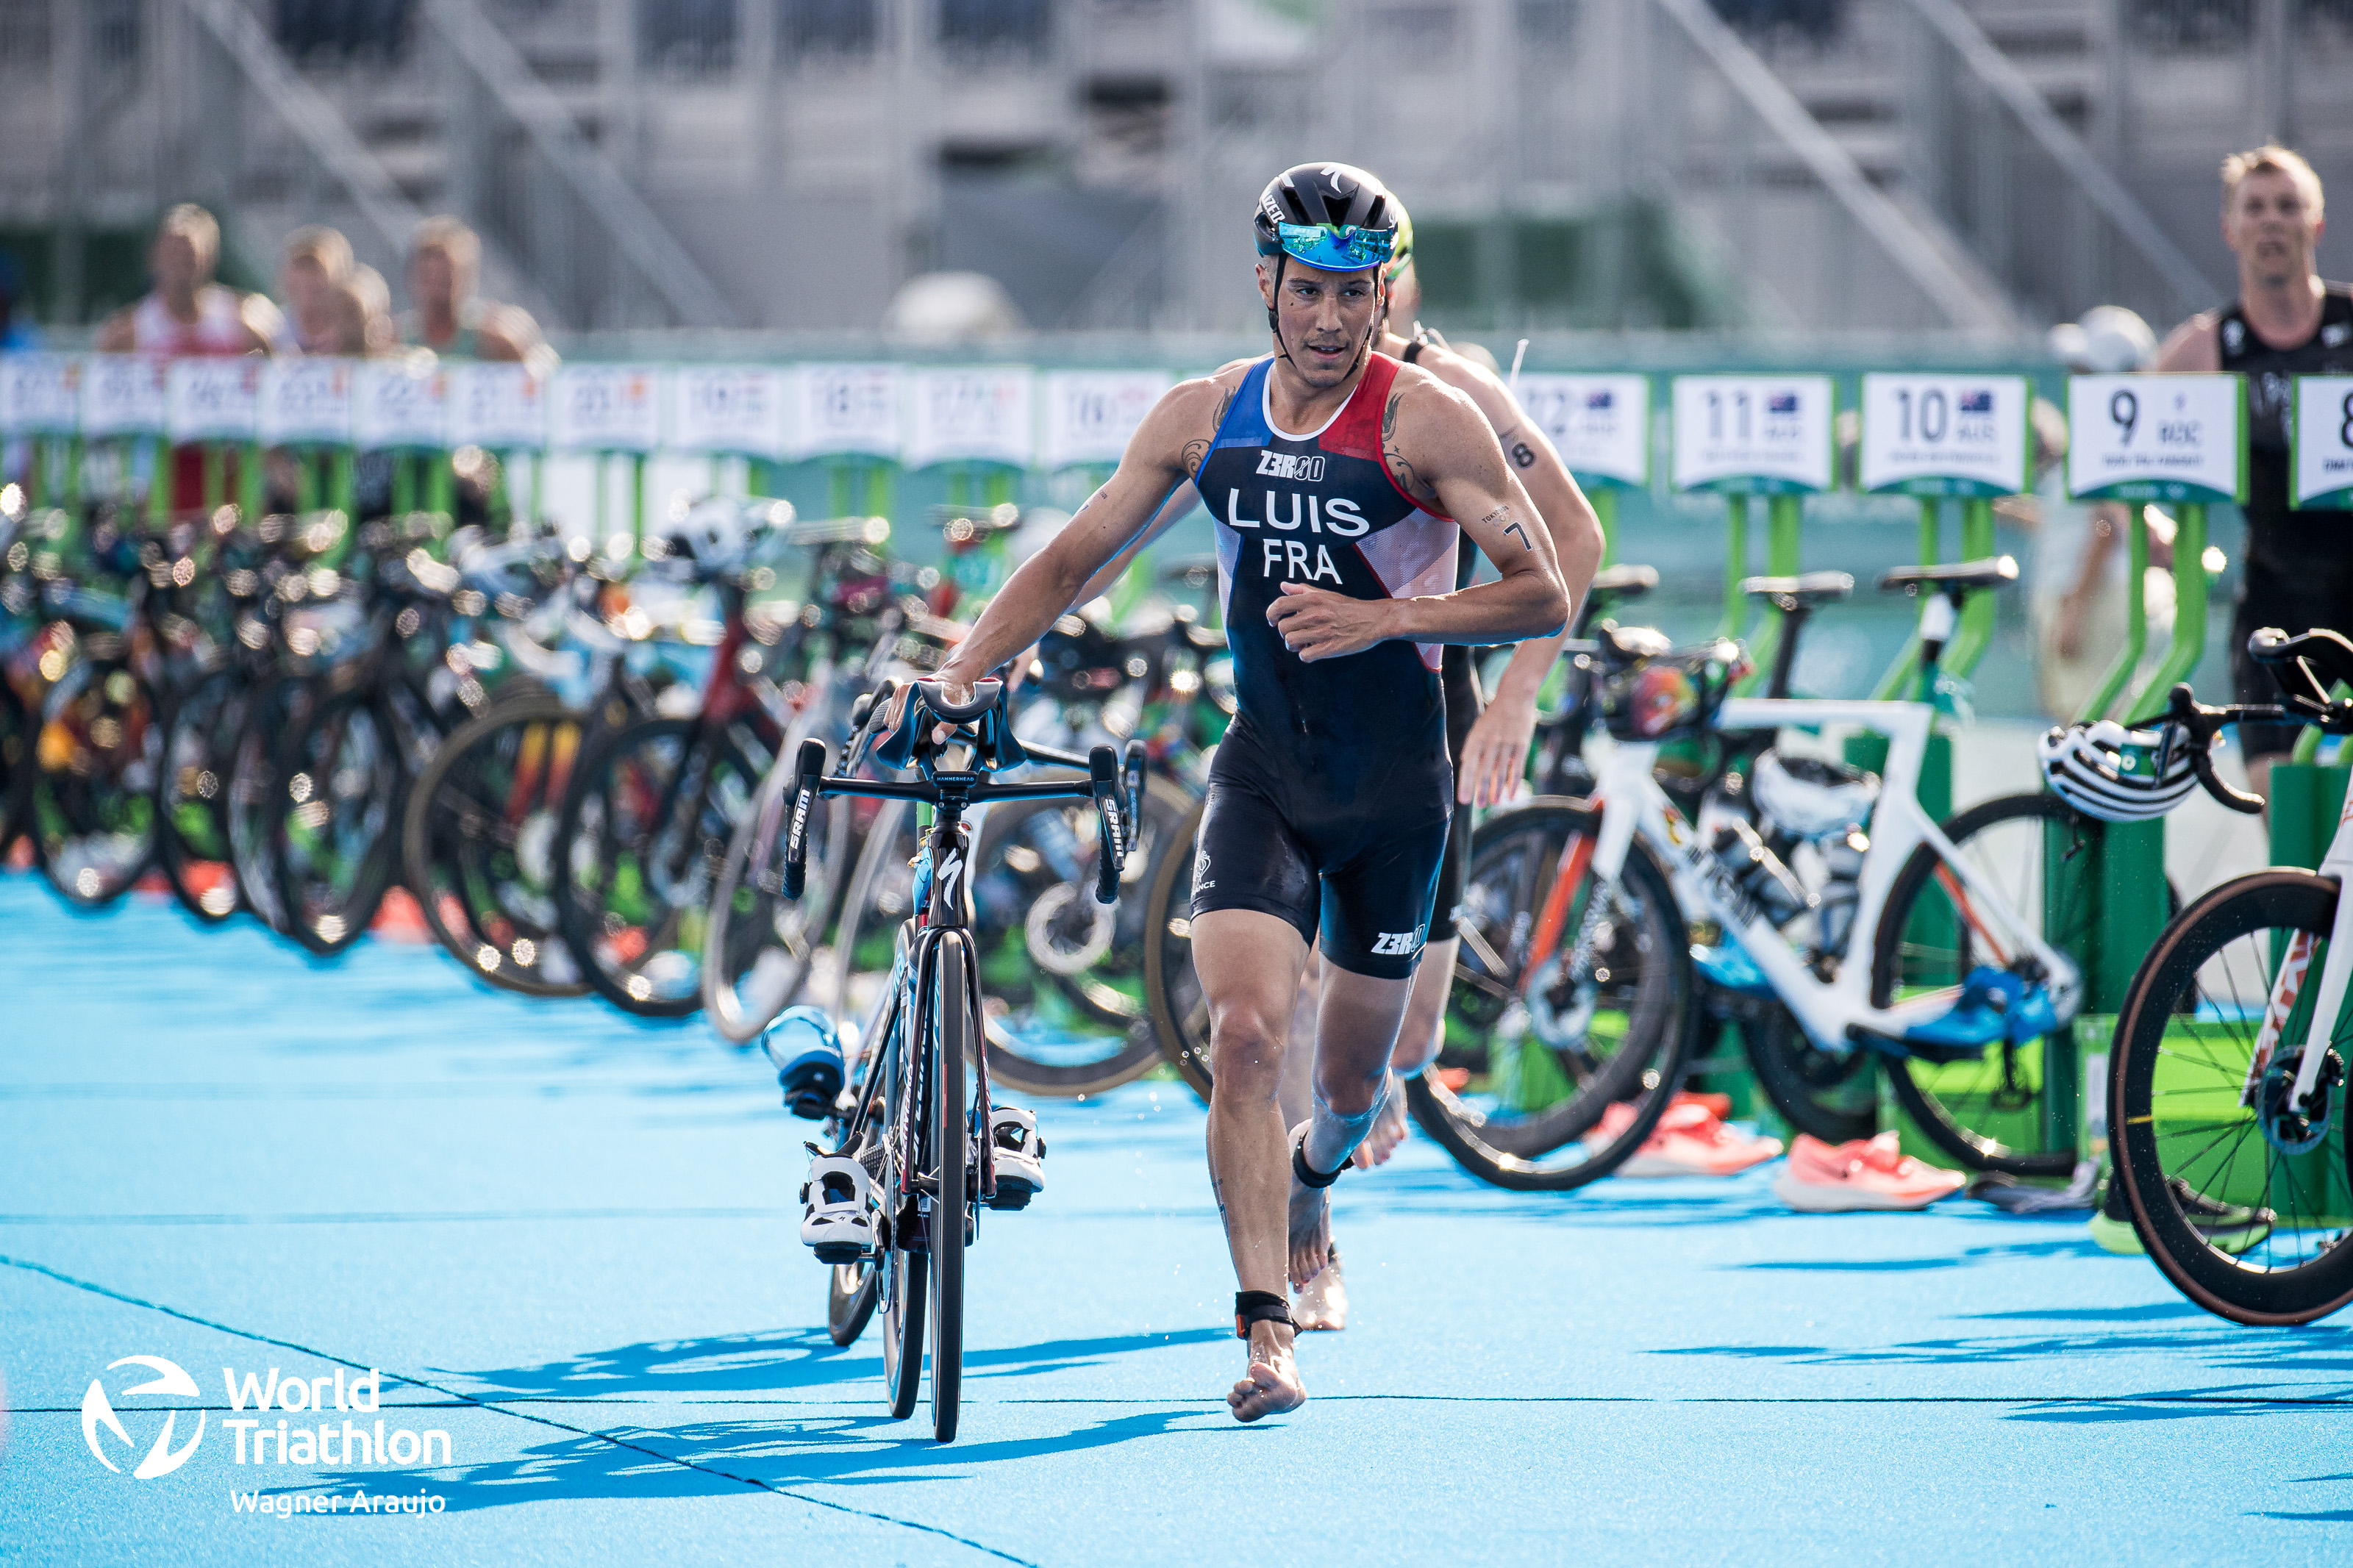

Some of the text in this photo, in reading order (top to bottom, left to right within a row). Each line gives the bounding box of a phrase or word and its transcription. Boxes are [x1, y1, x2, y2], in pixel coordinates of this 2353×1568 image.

[1702, 390, 1752, 438] 11
[1894, 388, 1948, 443] 10
[2109, 387, 2140, 447] 9
[1512, 443, 1536, 467] 8
[1228, 487, 1370, 537] LUIS
[1502, 521, 1533, 551] 7
[1263, 538, 1343, 584] FRA
[790, 789, 810, 849] SRAM
[1104, 798, 1124, 857] SRAM
